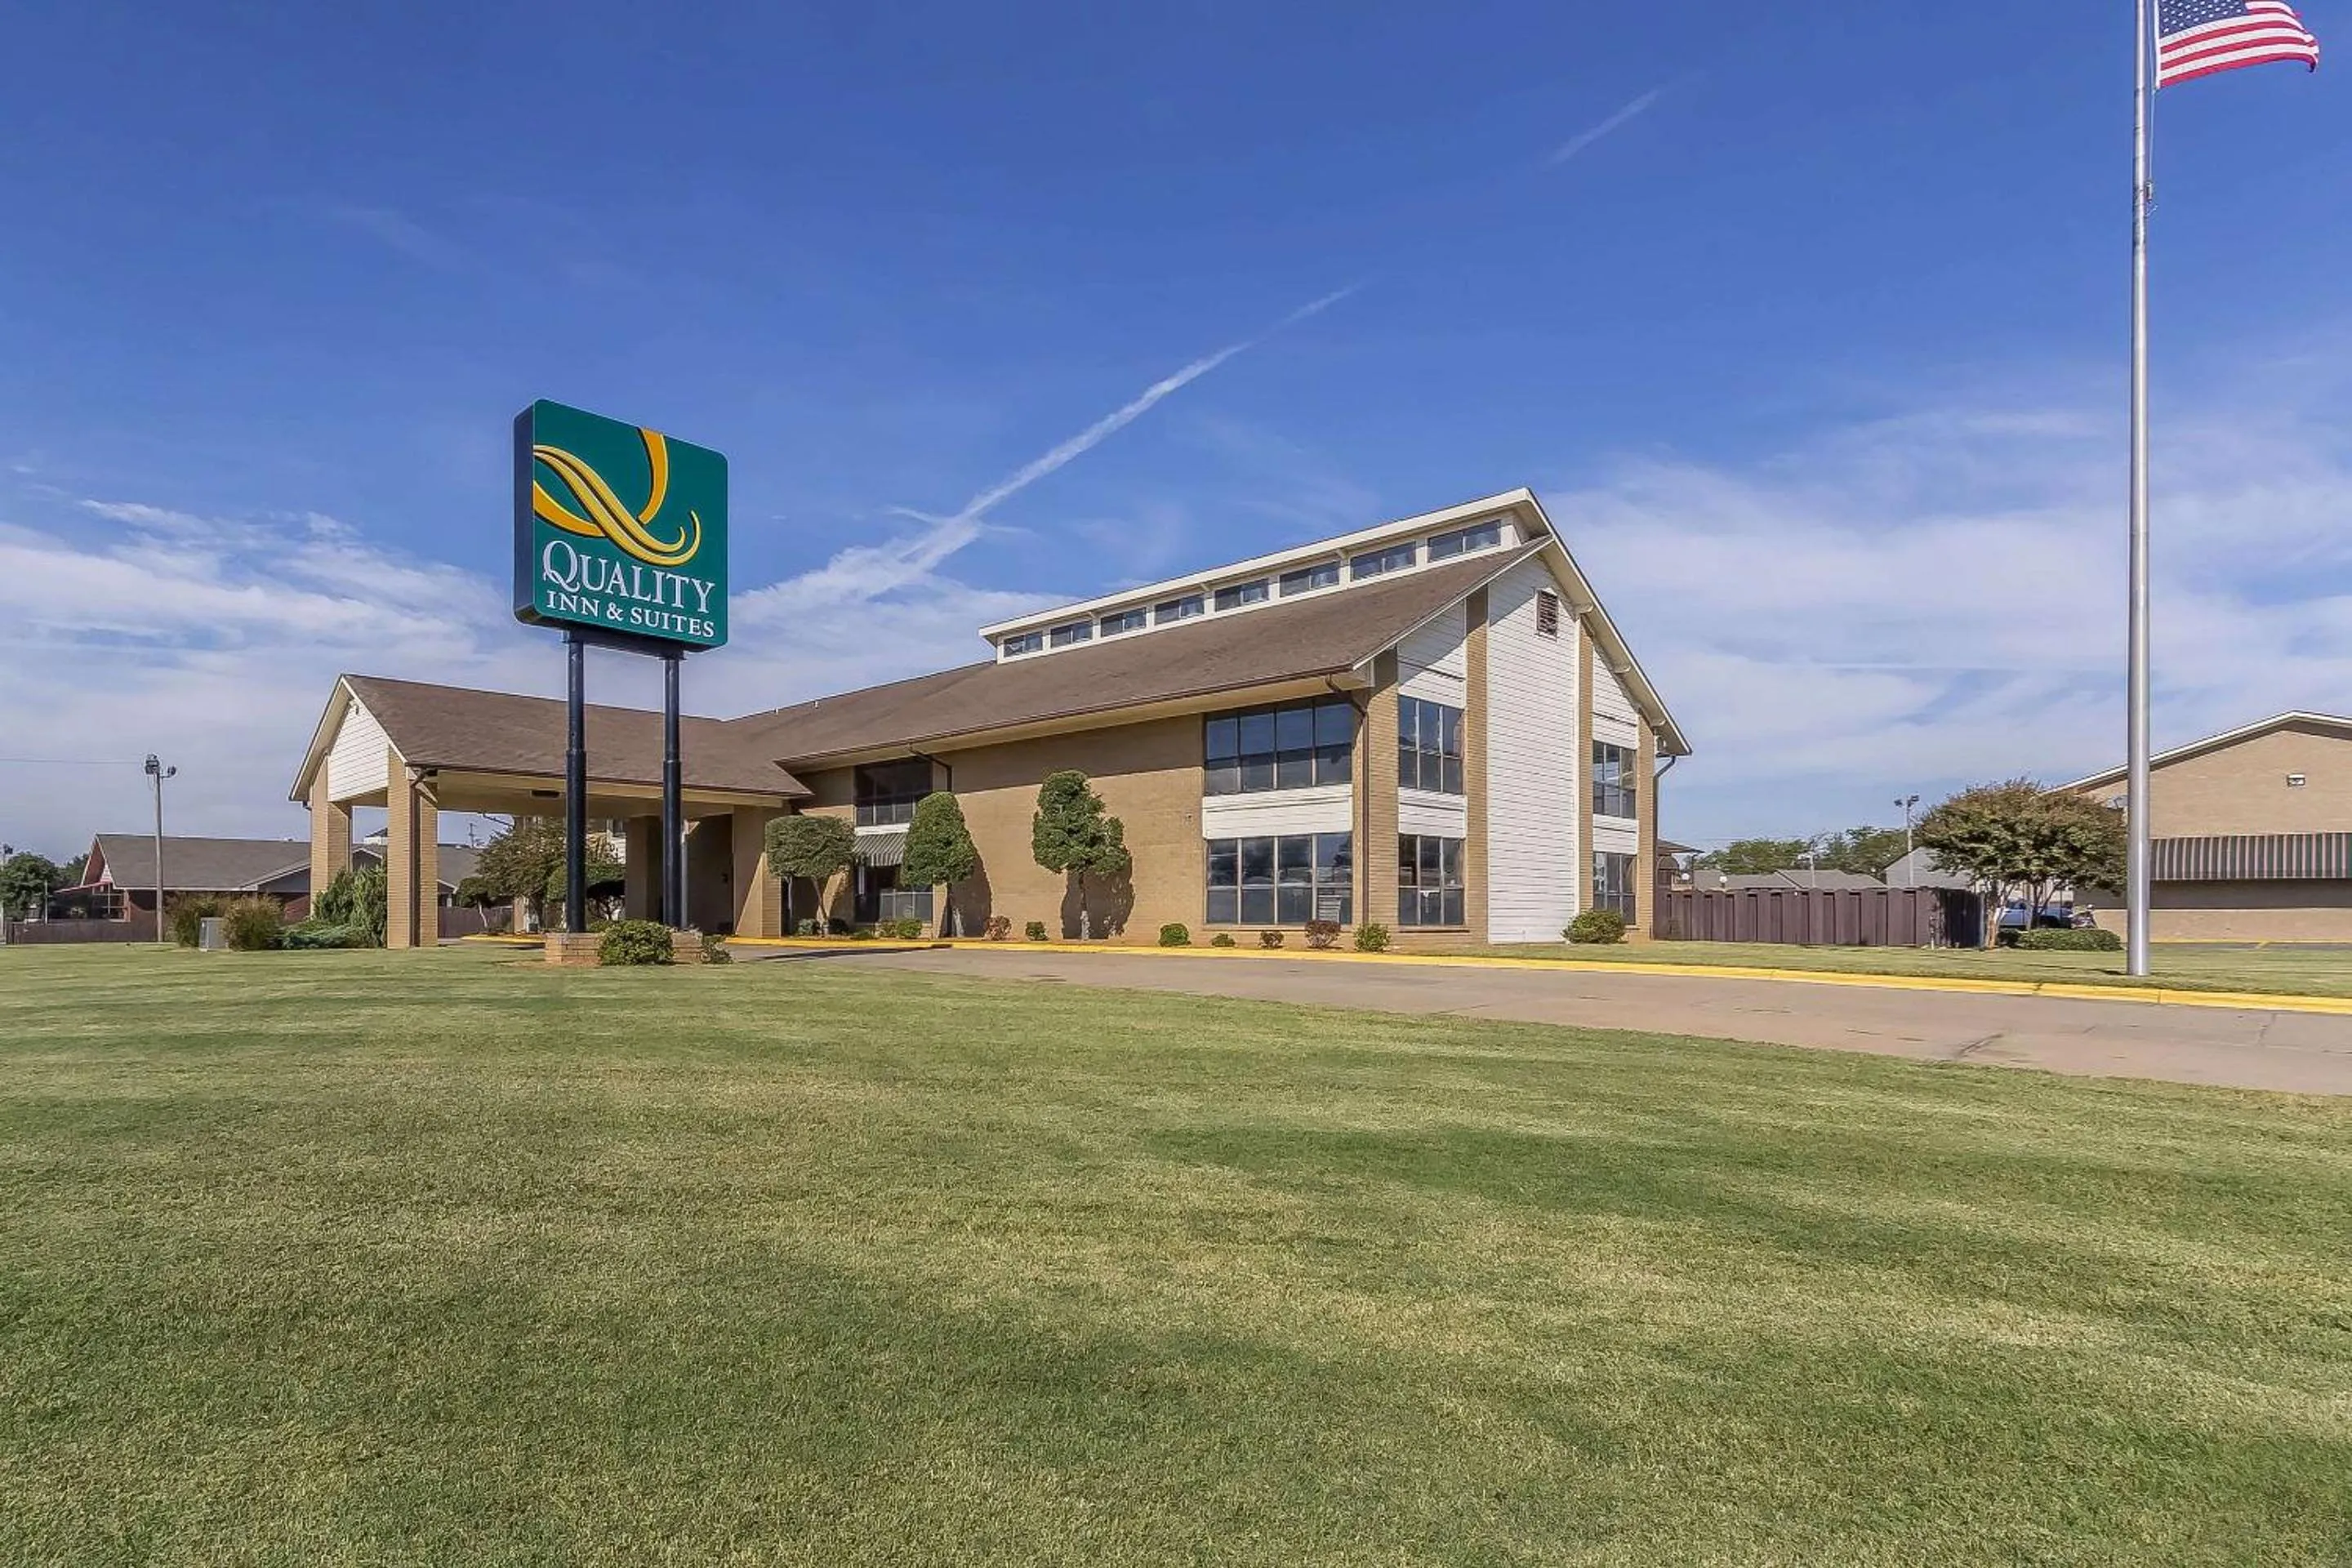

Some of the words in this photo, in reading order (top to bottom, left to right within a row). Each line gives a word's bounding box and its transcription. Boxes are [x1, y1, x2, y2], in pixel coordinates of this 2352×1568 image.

[542, 540, 715, 613] QUALITY
[546, 590, 600, 617] INN
[606, 602, 624, 621] &
[630, 606, 715, 638] SUITES
